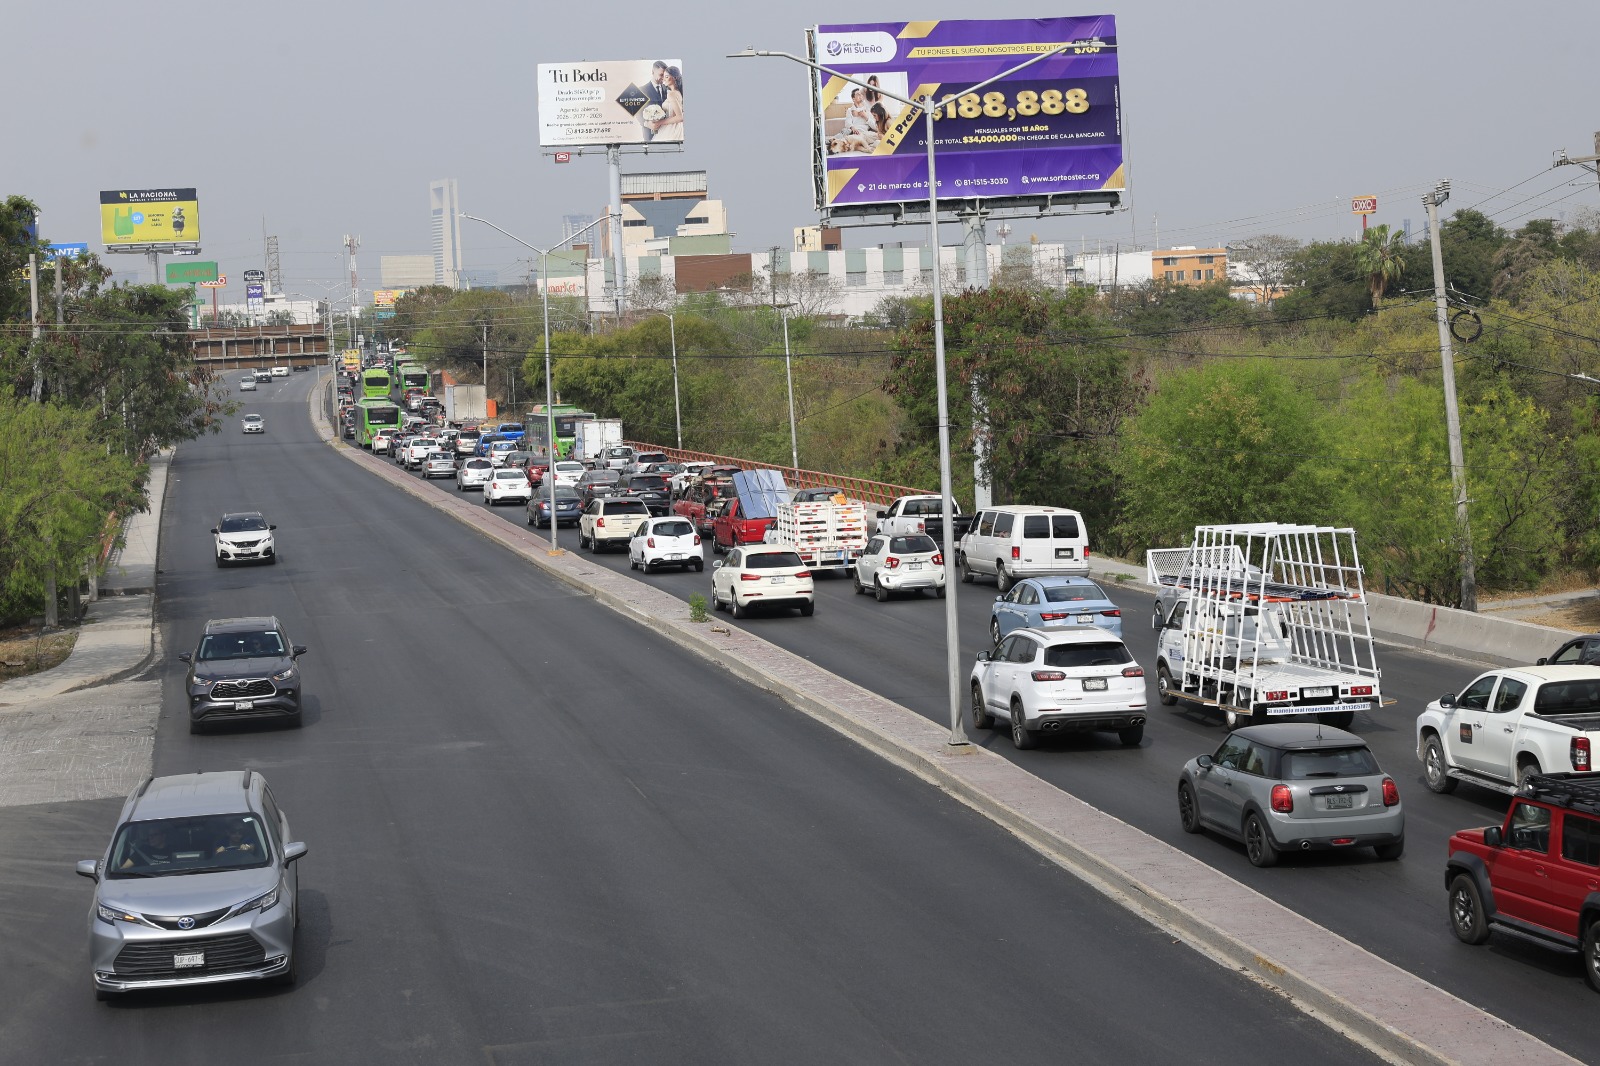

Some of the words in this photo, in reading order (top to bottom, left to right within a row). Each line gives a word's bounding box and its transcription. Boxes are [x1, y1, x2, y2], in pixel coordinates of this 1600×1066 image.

[854, 45, 883, 53] SUEÑO
[961, 46, 987, 54] SUEÑO,
[548, 69, 568, 83] Tu
[573, 68, 608, 83] Boda
[962, 133, 1017, 144] $34,000,000
[963, 178, 1009, 186] 81-1515-3030
[1030, 173, 1100, 183] www.sorteostec.org
[868, 183, 876, 191] 21
[877, 182, 887, 190] de
[912, 181, 922, 189] de
[1353, 199, 1372, 210] OXXO
